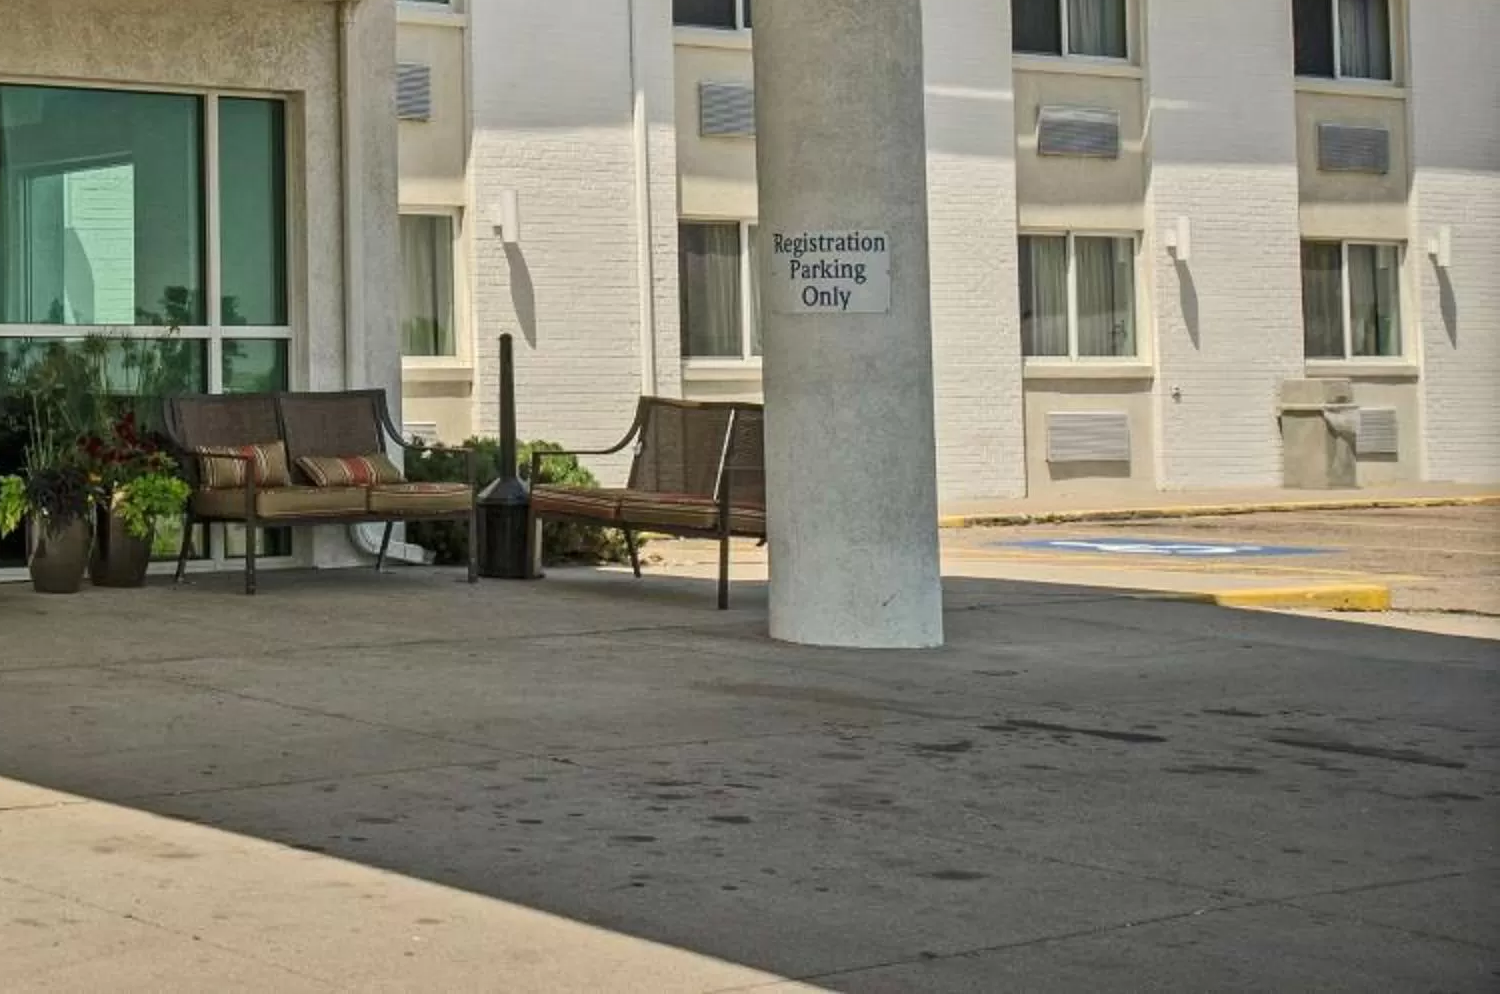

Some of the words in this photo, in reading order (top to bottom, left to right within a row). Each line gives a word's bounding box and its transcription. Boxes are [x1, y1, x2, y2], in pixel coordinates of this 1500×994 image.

[773, 231, 886, 258] Registration
[789, 259, 867, 285] Parking
[802, 285, 852, 311] Only
